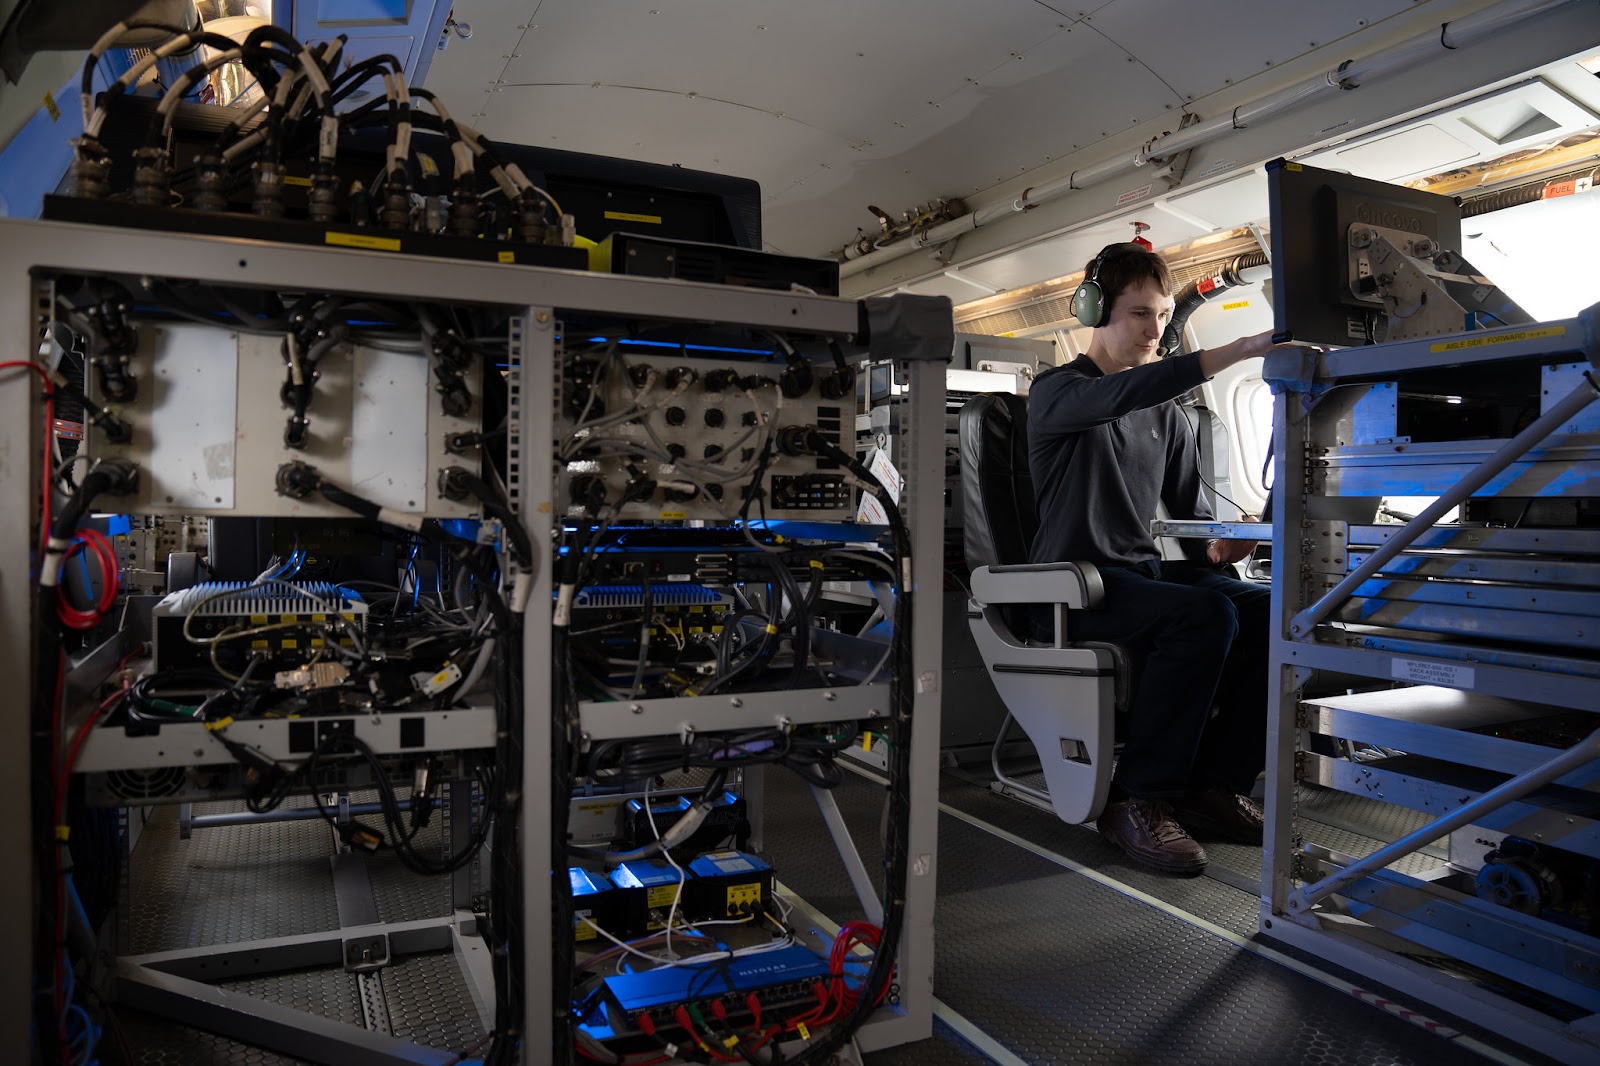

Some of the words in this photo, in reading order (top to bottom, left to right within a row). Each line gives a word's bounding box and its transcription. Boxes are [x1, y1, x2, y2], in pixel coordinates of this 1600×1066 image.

[1550, 185, 1572, 195] FUEL
[1374, 210, 1423, 232] neovo
[1200, 282, 1214, 290] FUEL
[1445, 341, 1468, 351] AISLE
[1467, 338, 1484, 347] SIDE
[1487, 332, 1526, 344] FORWARD
[1409, 667, 1424, 675] RACK
[1425, 670, 1456, 679] ASSEMBLY
[1409, 673, 1431, 681] WEIGHT
[738, 963, 787, 976] NETGEAR
